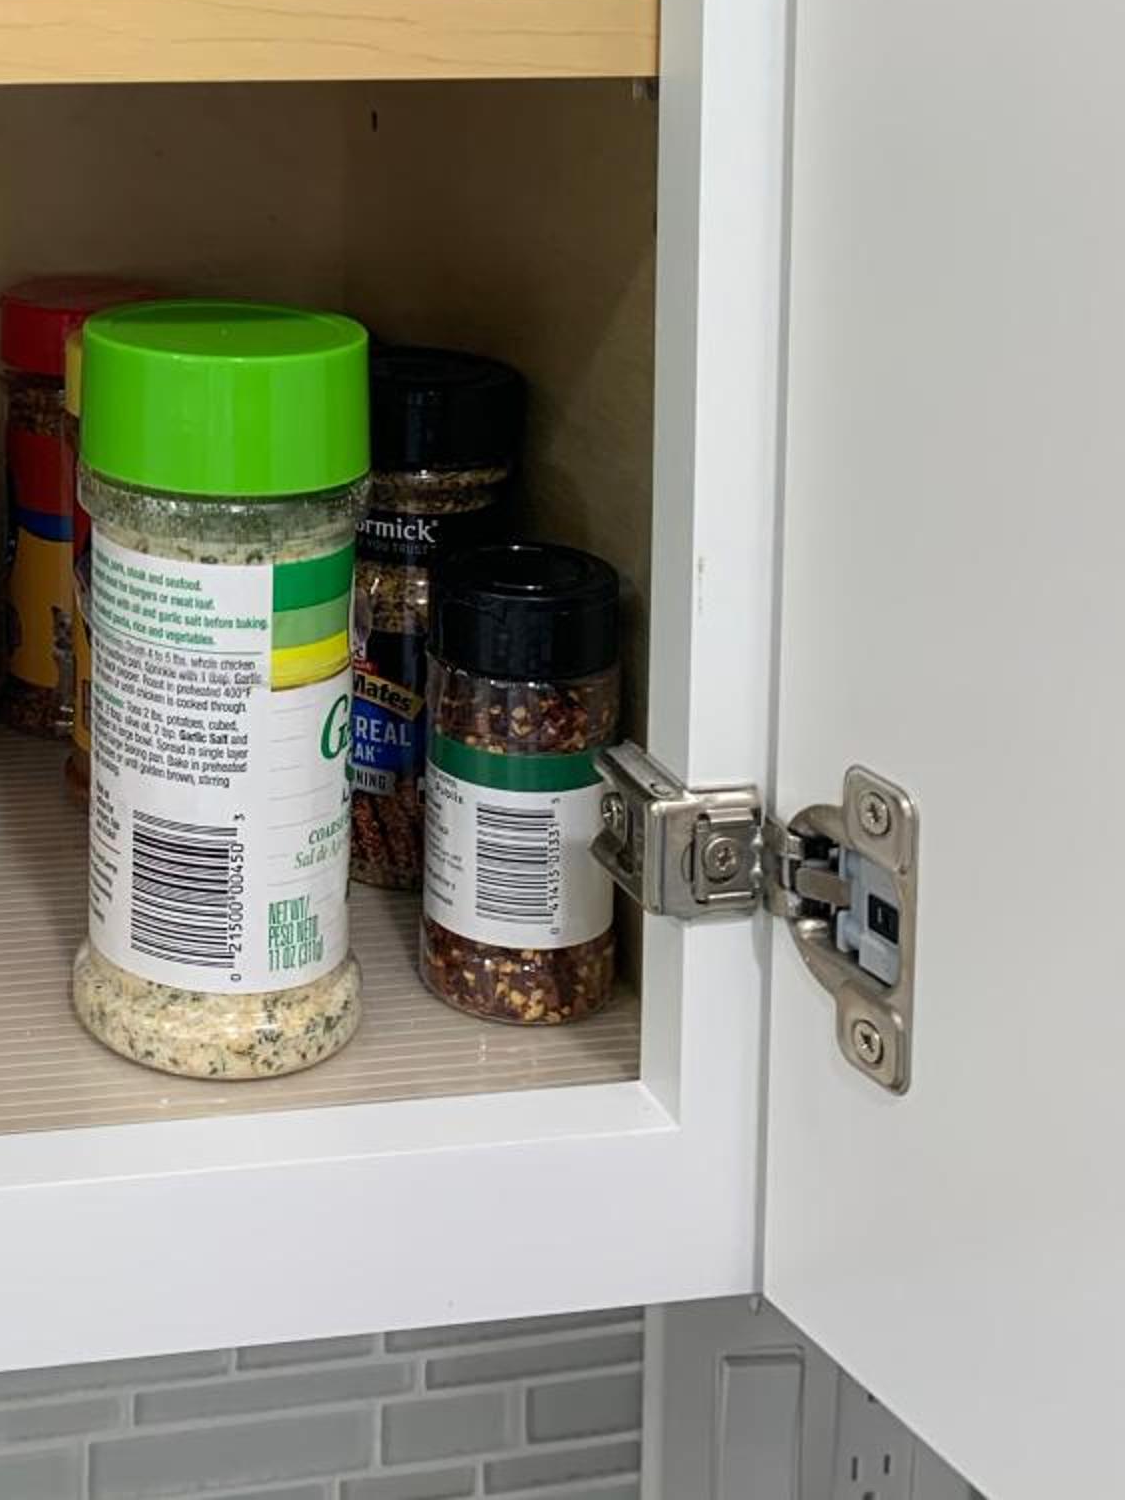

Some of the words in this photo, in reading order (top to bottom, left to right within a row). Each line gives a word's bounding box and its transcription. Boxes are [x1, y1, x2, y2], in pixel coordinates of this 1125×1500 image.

[203, 617, 233, 628] before
[190, 657, 218, 669] whole
[220, 660, 256, 671] chicken
[176, 697, 208, 711] cooked
[178, 729, 207, 744] Garlic
[209, 732, 229, 745] Salt
[230, 734, 248, 745] and
[355, 714, 412, 747] REAL
[198, 745, 225, 760] single
[226, 746, 249, 760] layer
[166, 754, 189, 768] Bake
[190, 758, 200, 770] in
[201, 760, 248, 773] preheated
[229, 843, 245, 895] 00450
[549, 869, 561, 911] 41415
[228, 901, 243, 953] 21500
[230, 974, 242, 982] 0
